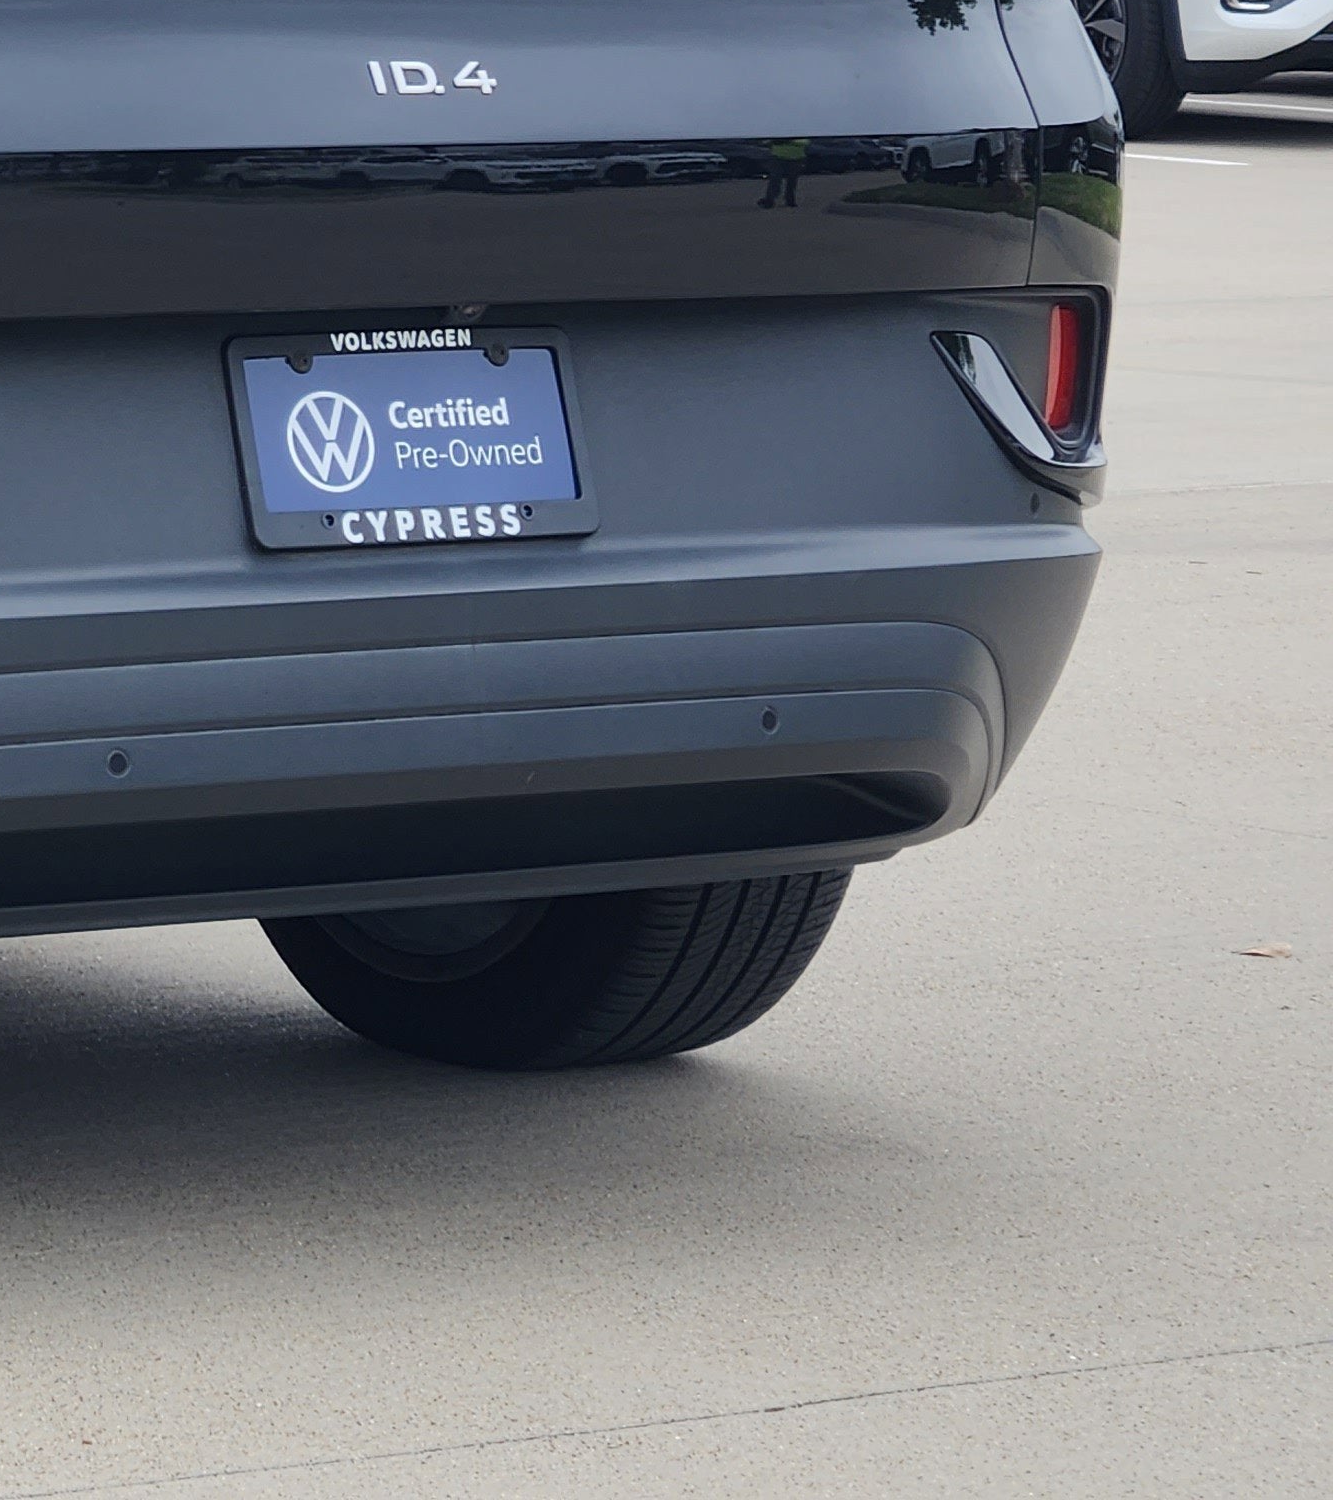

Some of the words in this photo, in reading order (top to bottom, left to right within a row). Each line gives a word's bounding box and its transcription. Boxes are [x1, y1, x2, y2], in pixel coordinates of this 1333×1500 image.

[367, 60, 497, 95] ID.4
[330, 328, 472, 353] VOLKSWAGEN
[388, 397, 510, 430] Certified
[289, 394, 373, 487] VW
[394, 436, 543, 470] Pre-Owned
[341, 503, 522, 545] CYPRESS
